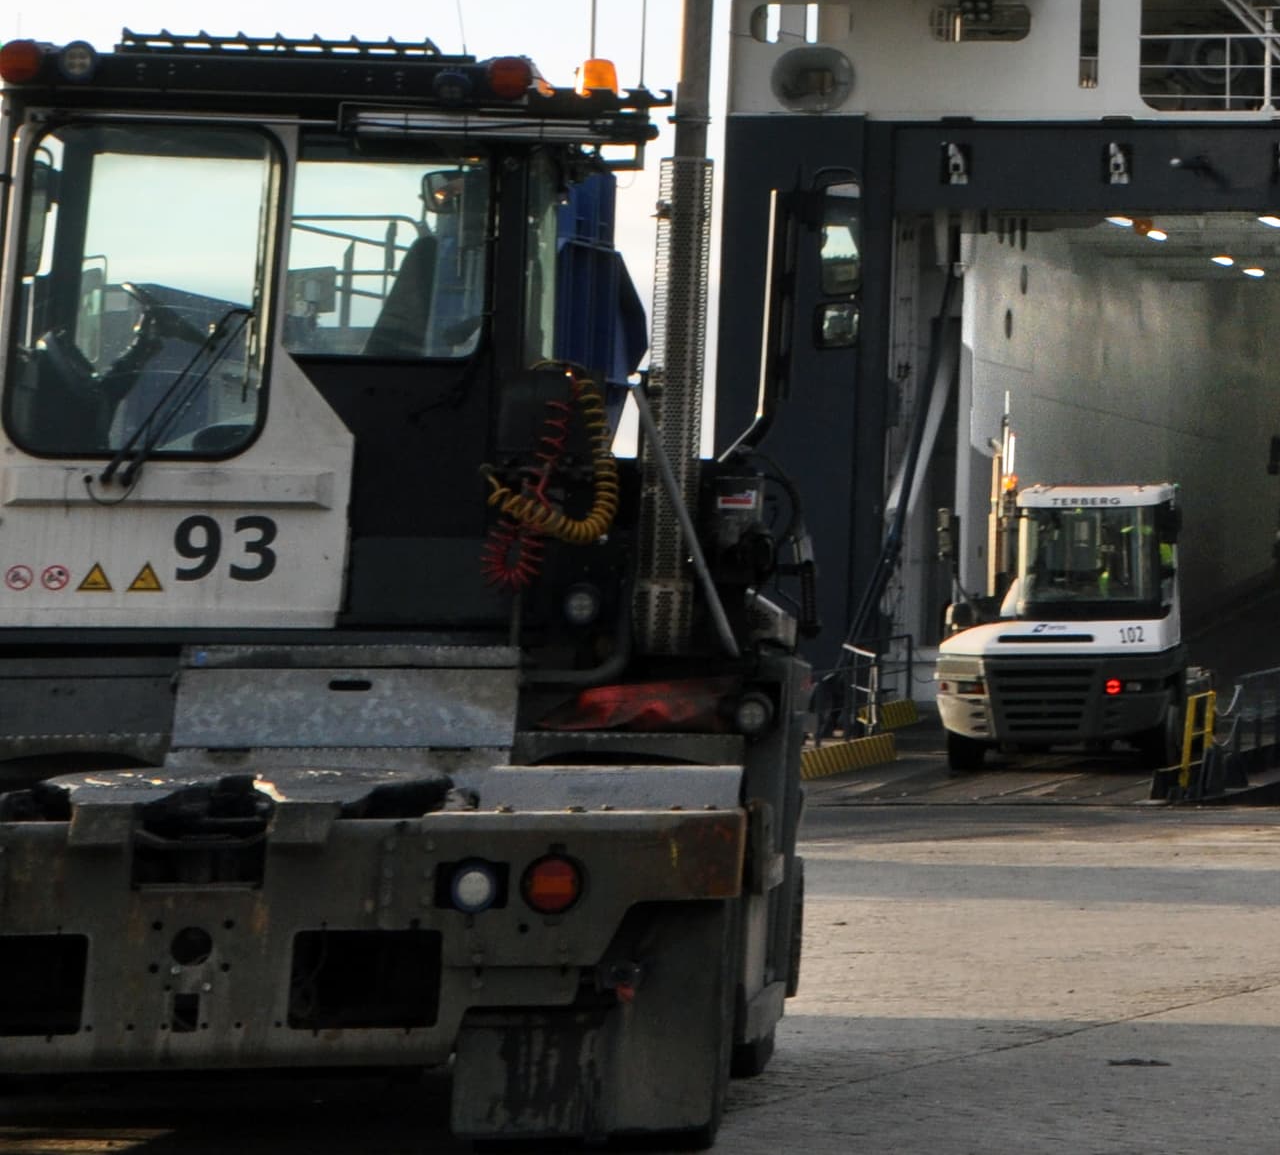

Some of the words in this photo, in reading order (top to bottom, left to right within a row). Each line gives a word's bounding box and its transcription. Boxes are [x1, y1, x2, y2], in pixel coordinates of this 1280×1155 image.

[1051, 497, 1121, 506] TERBERG
[173, 514, 278, 582] 93
[1119, 626, 1145, 644] 102
